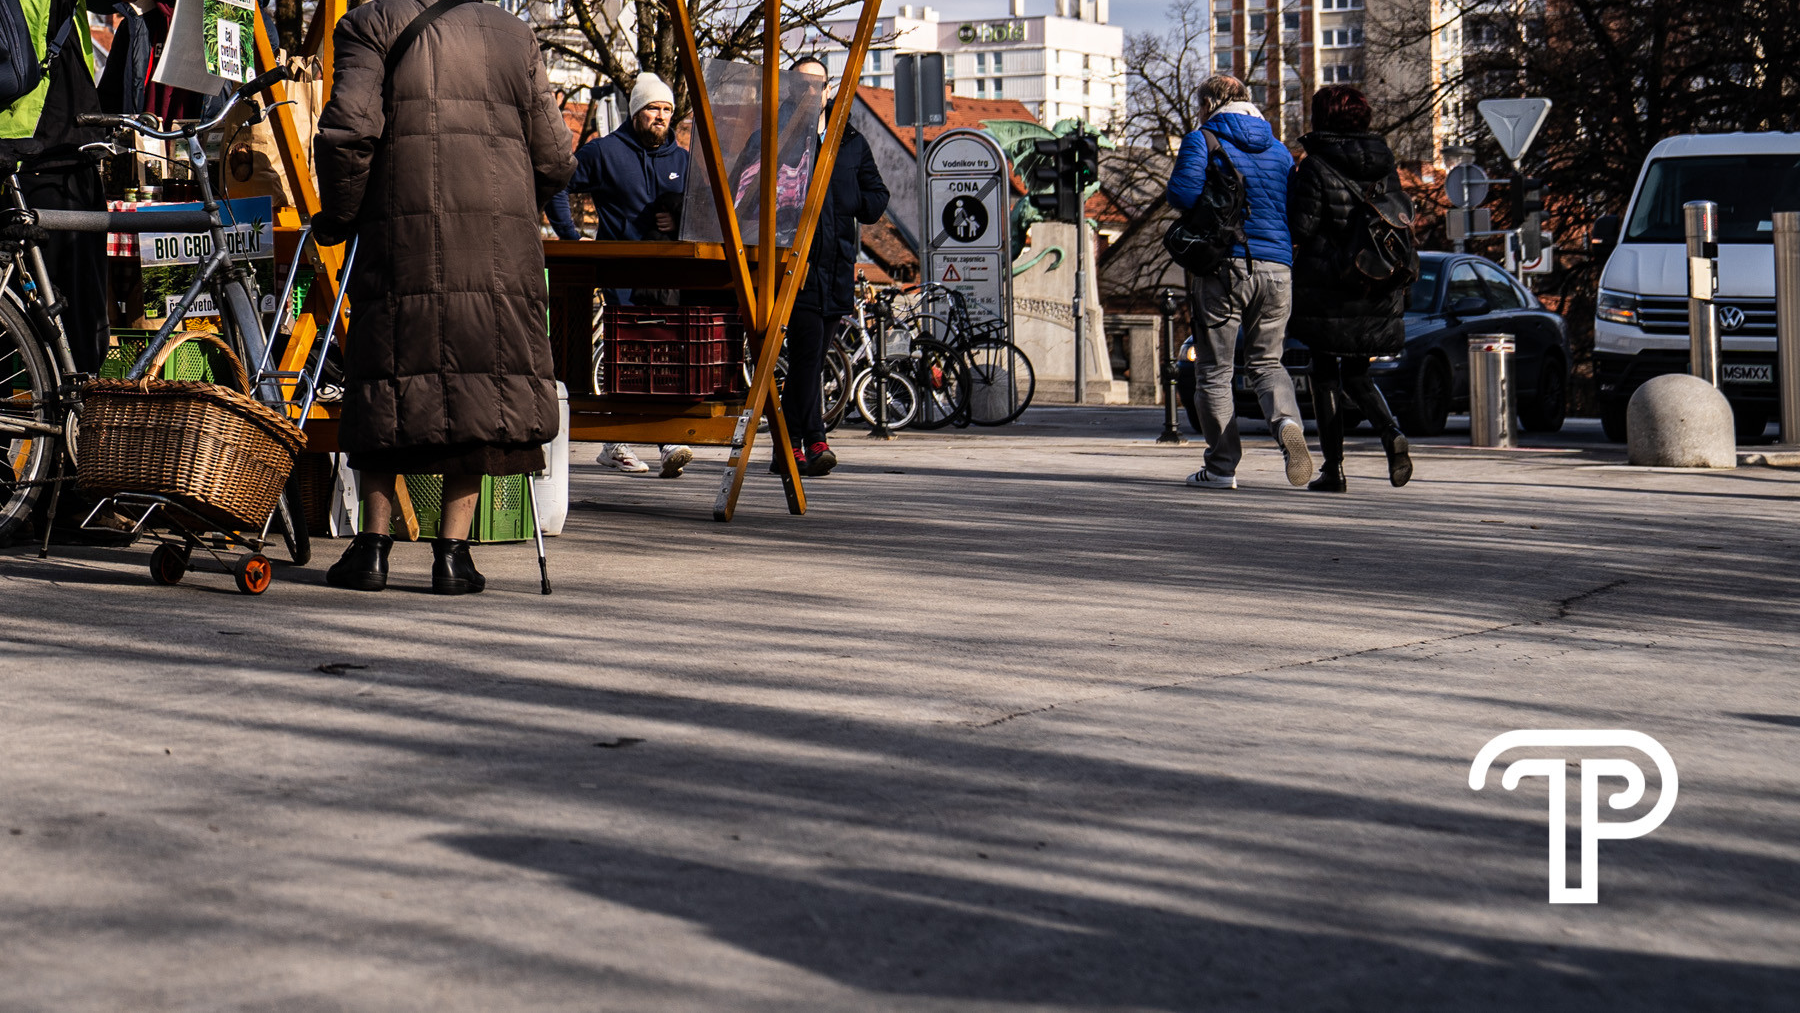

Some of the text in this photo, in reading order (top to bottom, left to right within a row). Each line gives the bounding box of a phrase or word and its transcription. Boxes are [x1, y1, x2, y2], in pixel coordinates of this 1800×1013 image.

[982, 20, 1029, 43] hotel
[942, 159, 989, 168] Vodnikov trg
[949, 181, 979, 193] CONA
[155, 230, 260, 260] BIO CBD DELKI
